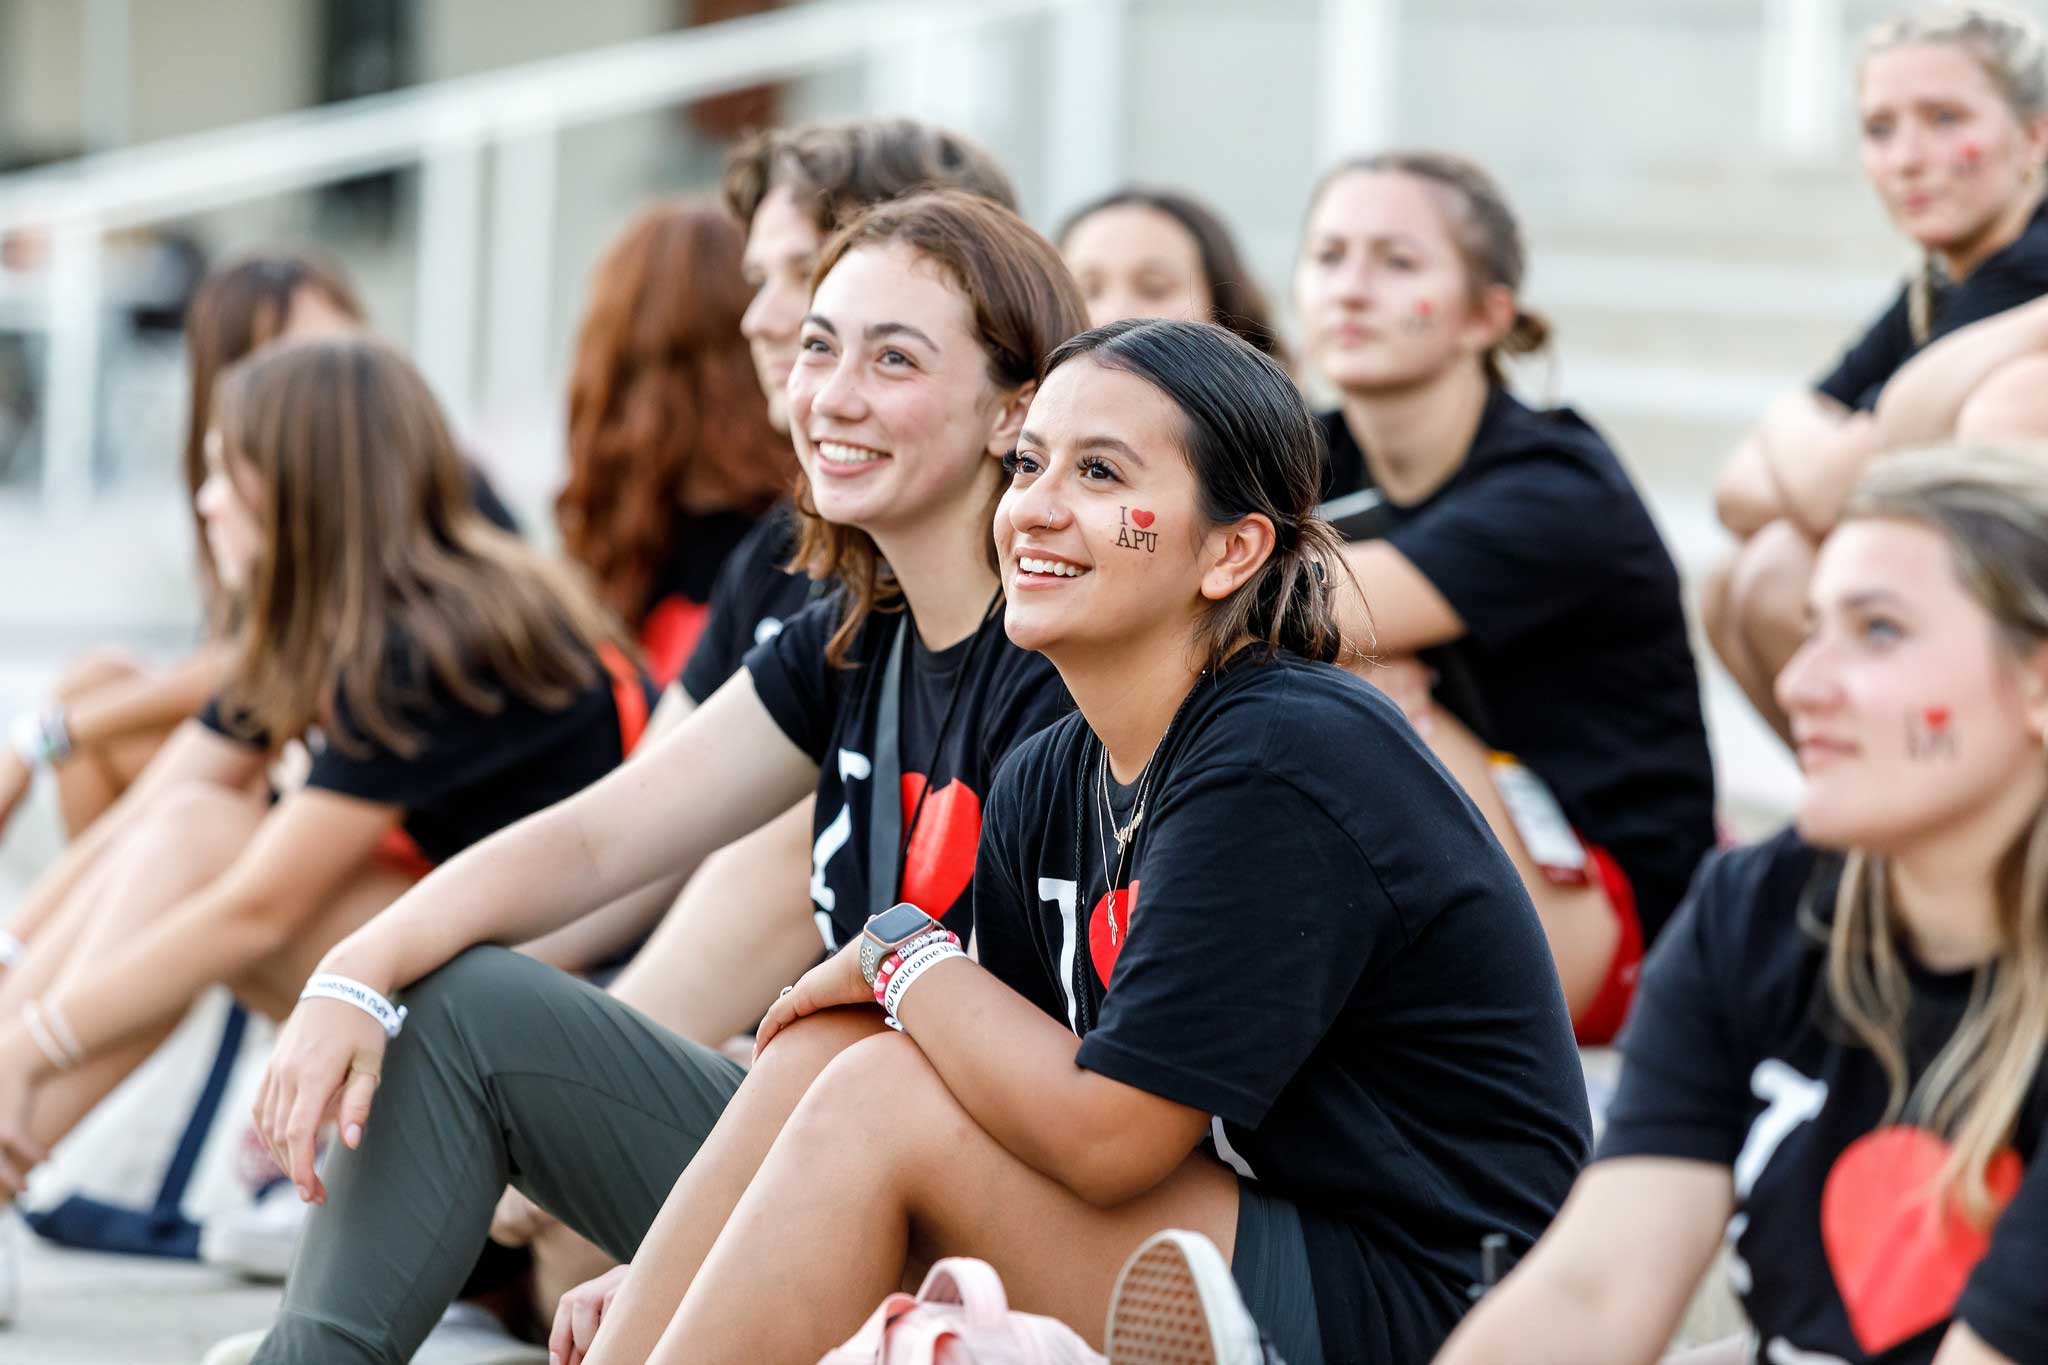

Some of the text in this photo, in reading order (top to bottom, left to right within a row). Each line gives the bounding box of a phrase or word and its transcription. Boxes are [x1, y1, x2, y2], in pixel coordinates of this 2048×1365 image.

[1119, 505, 1128, 526] I
[1115, 526, 1158, 553] APU
[890, 949, 940, 995] Welcome
